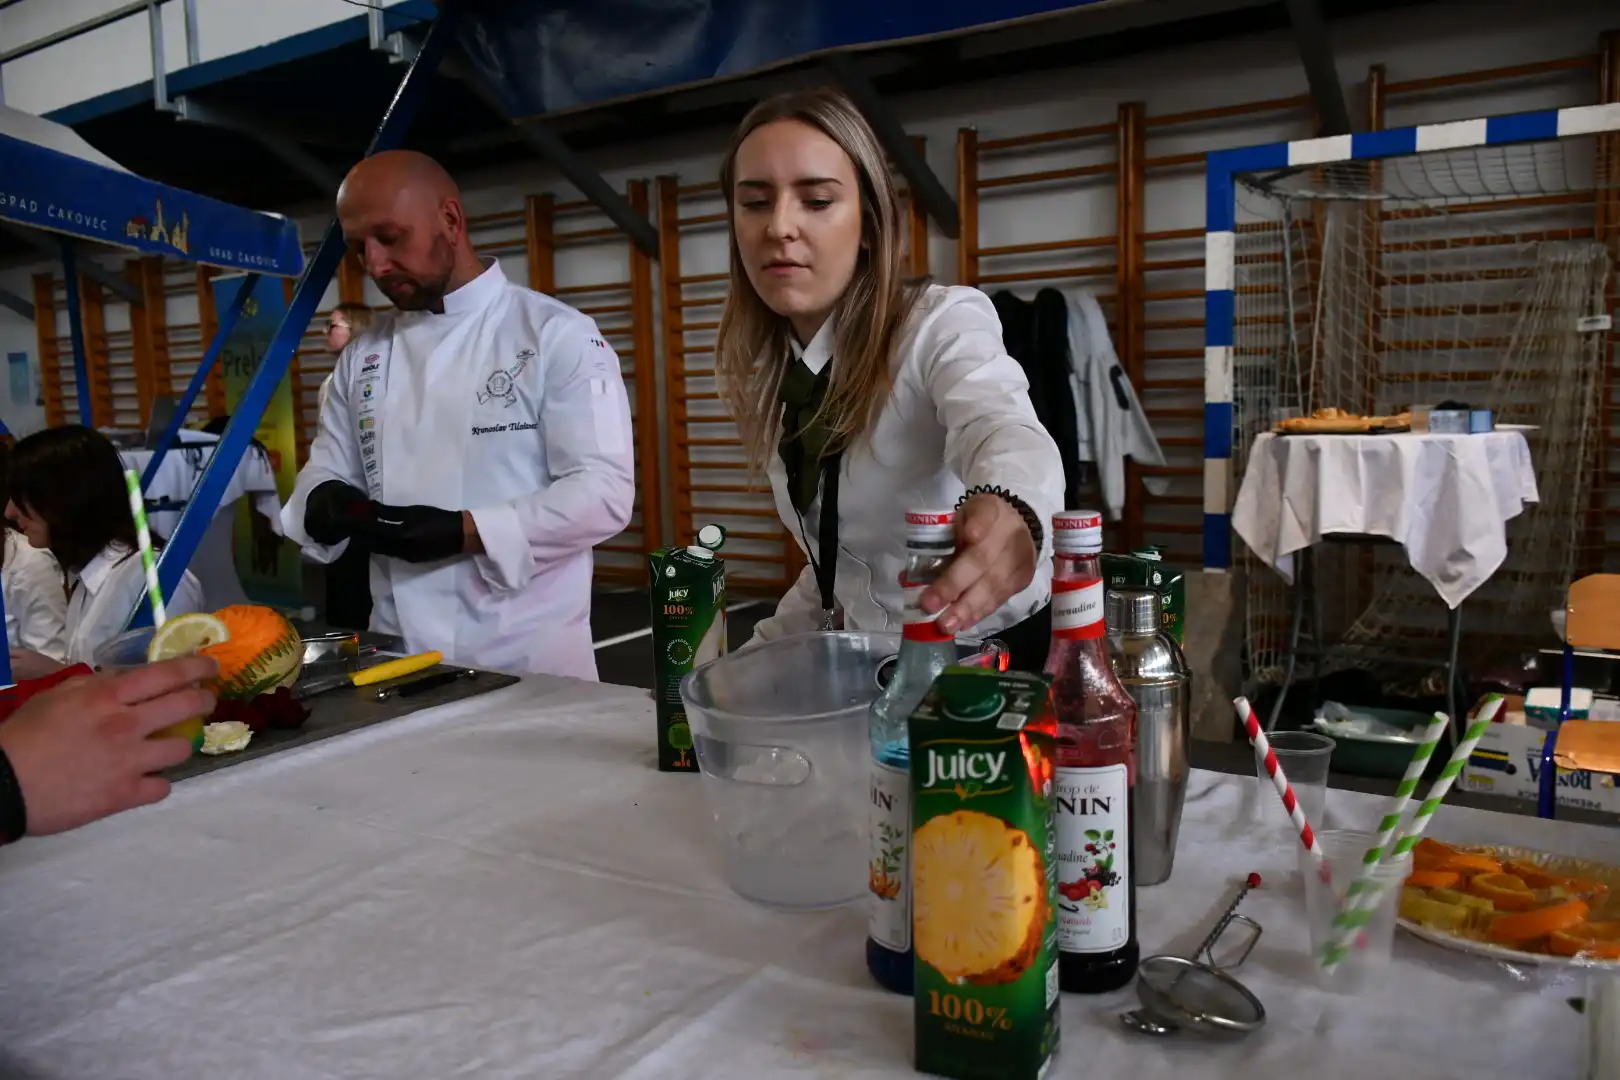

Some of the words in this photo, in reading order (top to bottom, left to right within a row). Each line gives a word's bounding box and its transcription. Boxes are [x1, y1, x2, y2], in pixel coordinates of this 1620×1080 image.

[0, 192, 37, 213] GRAD
[668, 588, 689, 601] Juicy
[663, 604, 694, 615] 100%
[922, 748, 1006, 788] Juicy
[1056, 796, 1112, 815] NIN
[1555, 796, 1602, 810] PREMIU
[1058, 850, 1088, 863] nadine
[928, 988, 1013, 1030] 100%
